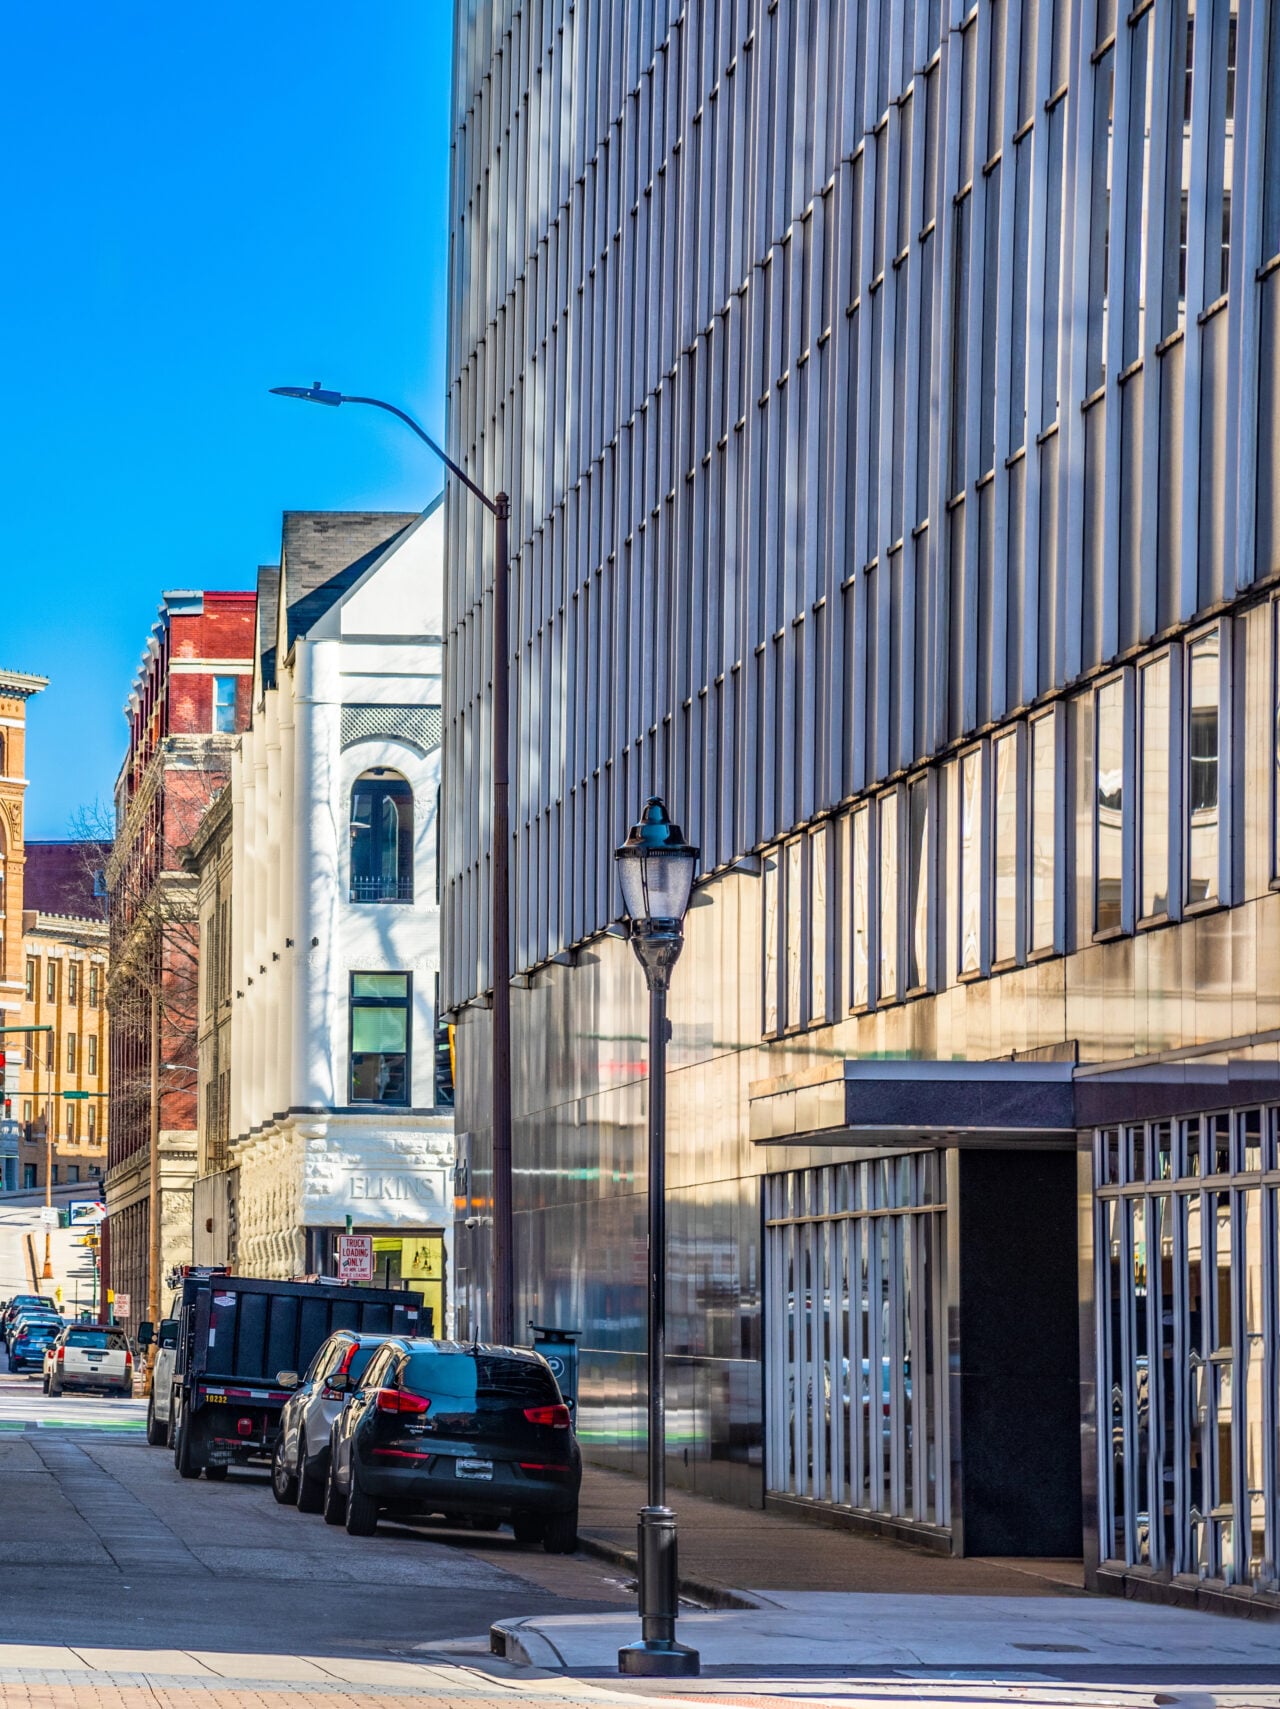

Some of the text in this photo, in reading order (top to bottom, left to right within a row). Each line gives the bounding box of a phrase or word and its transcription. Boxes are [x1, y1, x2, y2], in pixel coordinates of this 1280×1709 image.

[350, 1177, 435, 1200] ELKINS
[346, 1238, 365, 1247] TRUCK
[342, 1249, 369, 1257] LOADING
[348, 1258, 363, 1267] ONLY
[206, 1394, 228, 1403] 10232
